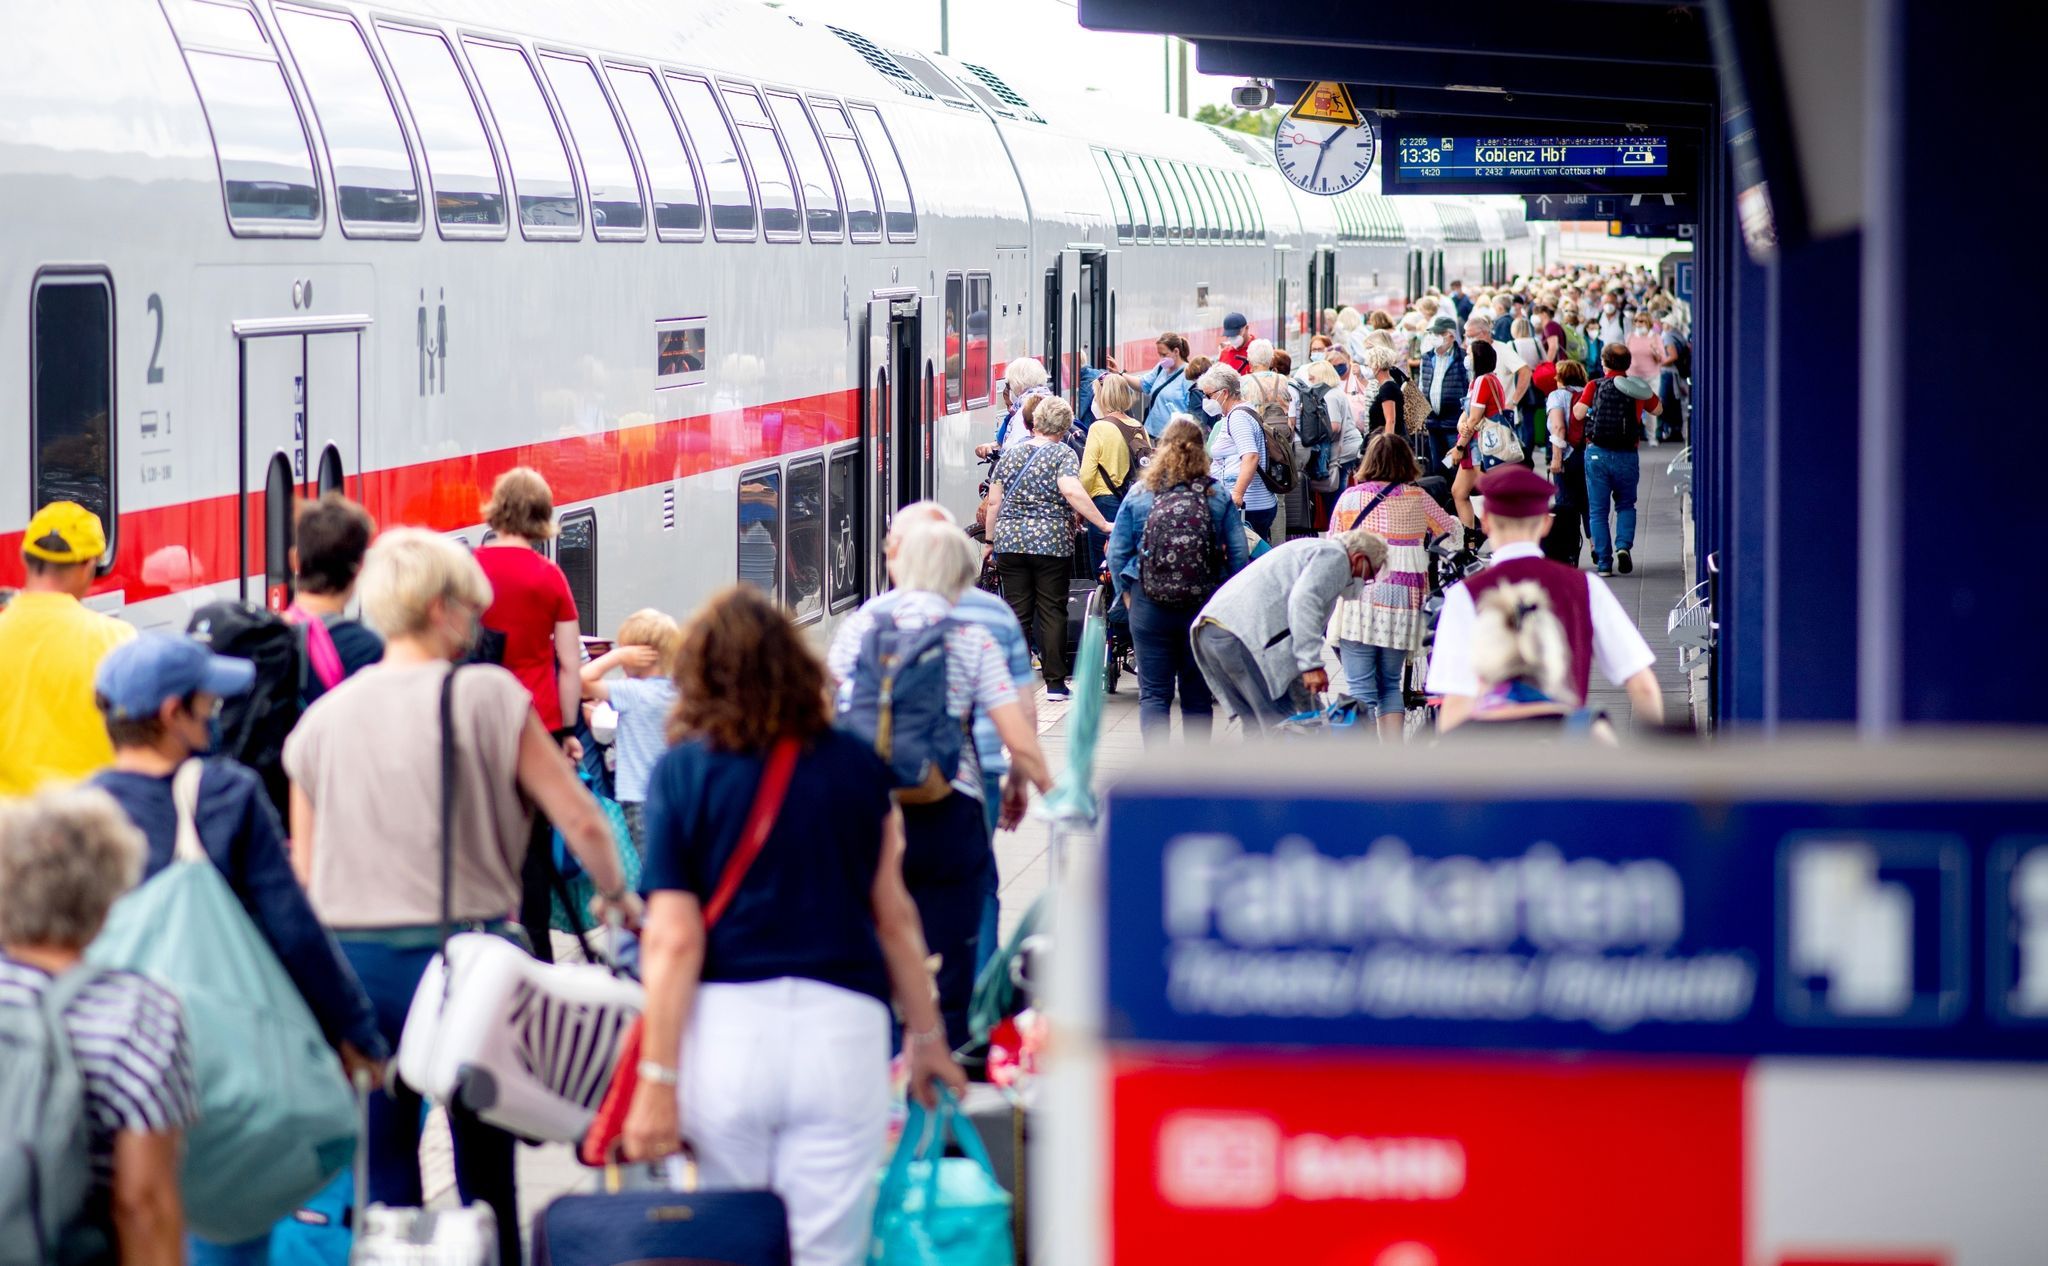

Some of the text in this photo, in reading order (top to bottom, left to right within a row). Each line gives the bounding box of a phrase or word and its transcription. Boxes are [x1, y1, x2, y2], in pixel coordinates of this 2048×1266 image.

[1400, 138, 1428, 146] IC 2205
[1400, 148, 1441, 163] 13:36
[1475, 147, 1567, 163] Koblenz Hbf
[1420, 168, 1441, 176] 14:20
[1475, 168, 1483, 176] IC
[1485, 168, 1503, 176] 2432
[1509, 168, 1541, 176] Ankunft
[1559, 167, 1591, 175] Cottbus
[1593, 167, 1607, 175] Hbf
[1564, 194, 1588, 204] Juist
[146, 292, 165, 385] 2
[1162, 833, 1684, 950] Fahrkarten
